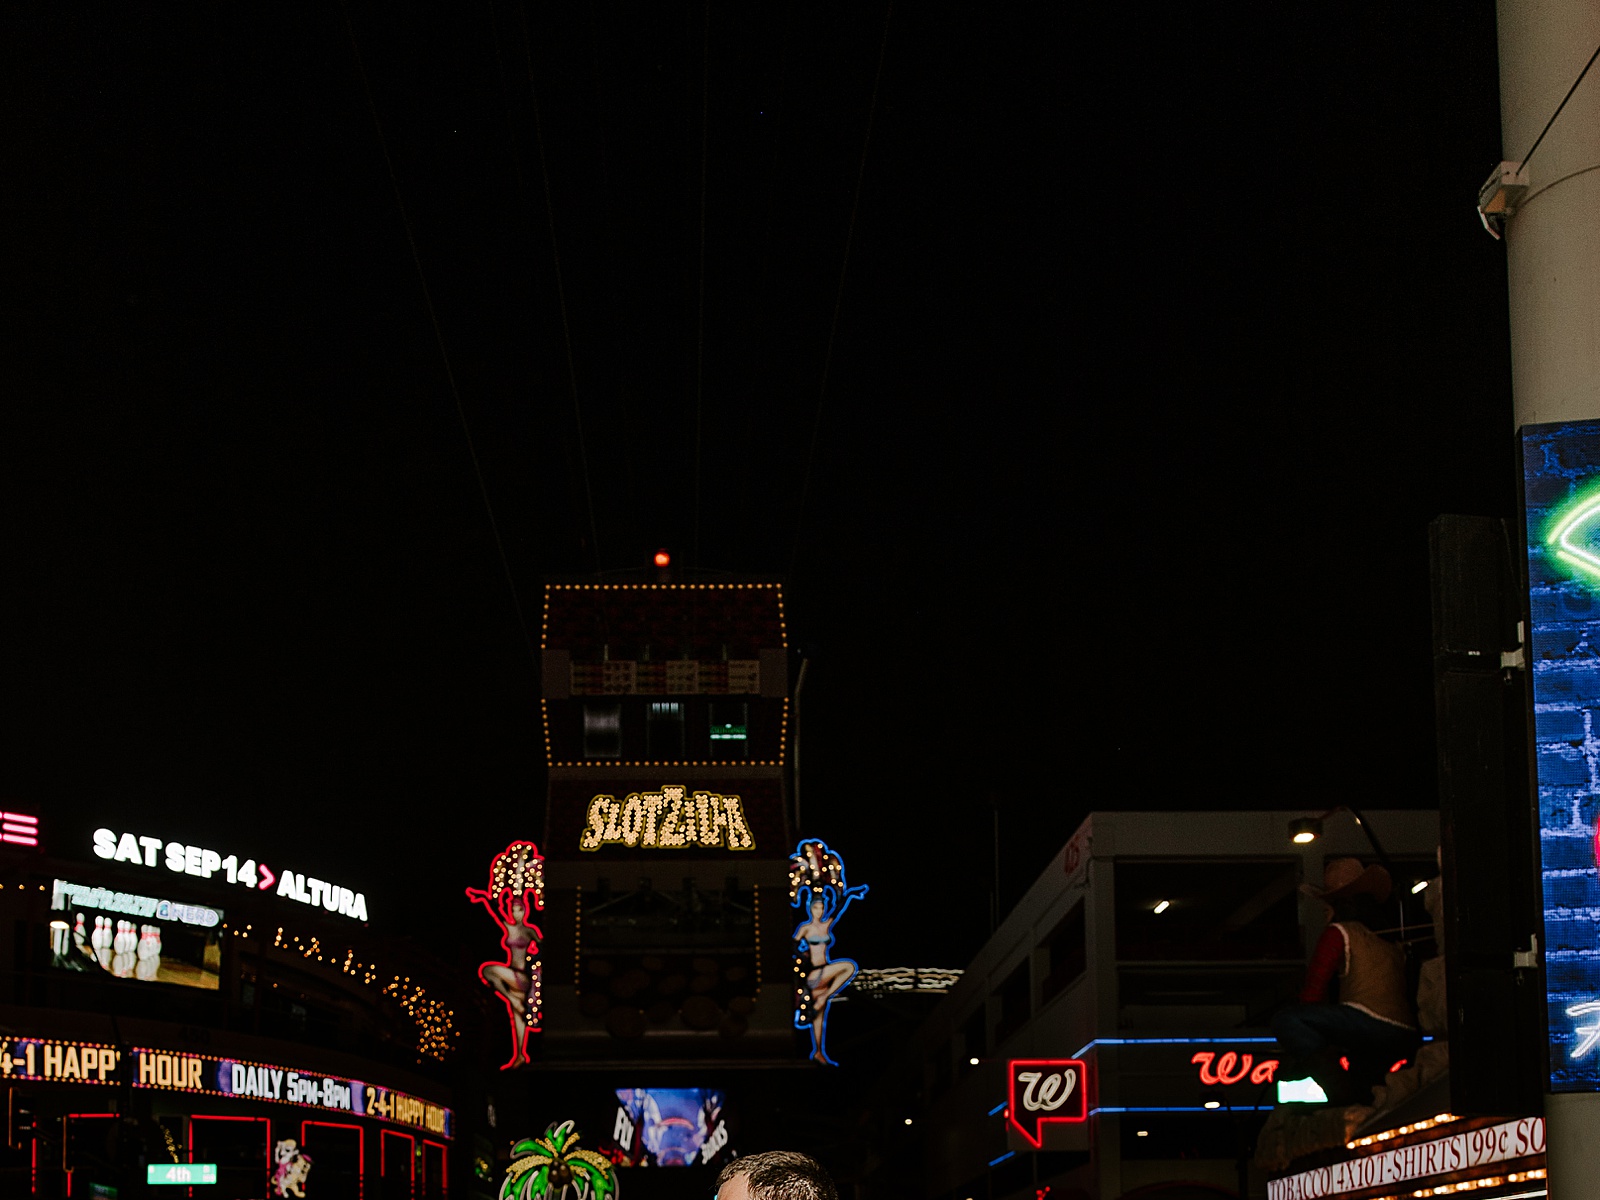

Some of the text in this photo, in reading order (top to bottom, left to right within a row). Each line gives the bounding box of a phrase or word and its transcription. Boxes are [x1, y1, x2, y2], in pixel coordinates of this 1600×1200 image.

[93, 828, 162, 867] SAT
[276, 870, 368, 921] ALTURA
[44, 1044, 121, 1081] HAPP
[139, 1052, 203, 1089] HOUR
[231, 1064, 283, 1099] DAILY
[287, 1072, 350, 1110] 5PM-8PM
[367, 1087, 395, 1117] 2-4-1
[395, 1095, 425, 1126] HAPPY
[166, 1166, 191, 1182] 4th
